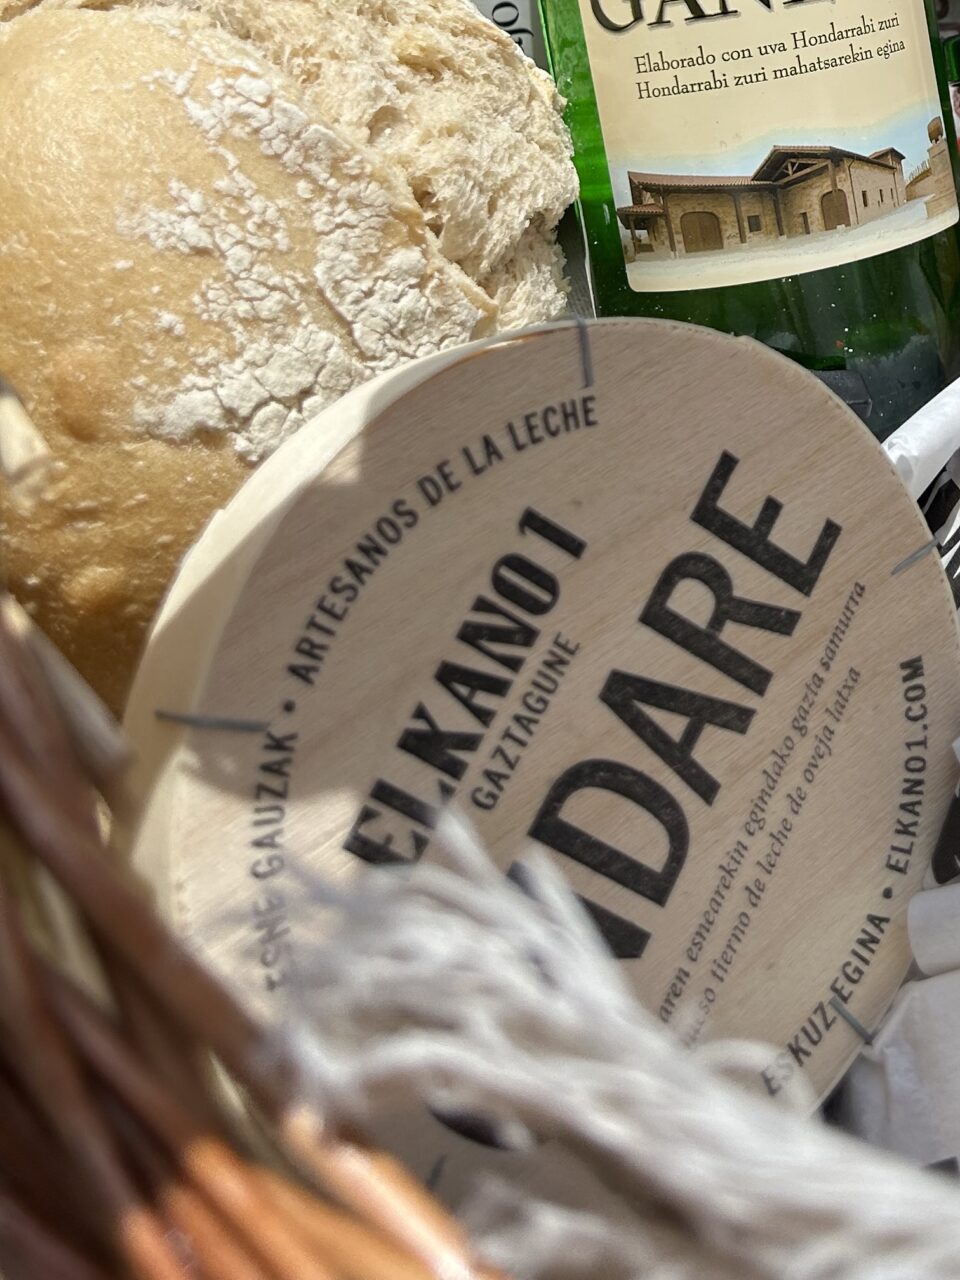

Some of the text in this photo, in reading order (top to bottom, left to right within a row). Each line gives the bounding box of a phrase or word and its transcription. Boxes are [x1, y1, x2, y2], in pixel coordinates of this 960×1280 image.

[634, 12, 900, 74] Elaborado con uva Hondarrabi zuri
[635, 39, 906, 100] Hondarrabi zuri mahatsarekin egina
[250, 729, 299, 880] GAUZAK
[286, 498, 420, 686] ARTESANOS
[417, 458, 463, 508] DE
[462, 433, 504, 476] LA
[506, 395, 599, 451] LECHE
[470, 631, 581, 812] GAZTAGUNE
[685, 838, 750, 965] esnearekin
[743, 734, 796, 838] egindako
[791, 671, 826, 739] gazta
[820, 580, 867, 672] samurra
[710, 910, 751, 985] tierno
[743, 874, 767, 909] de
[756, 816, 793, 877] leche
[786, 785, 808, 816] de
[803, 723, 836, 785] oveja
[824, 665, 862, 723] latxa
[830, 912, 892, 1006] EGINA
[884, 654, 928, 877] ELKANO1.COM
